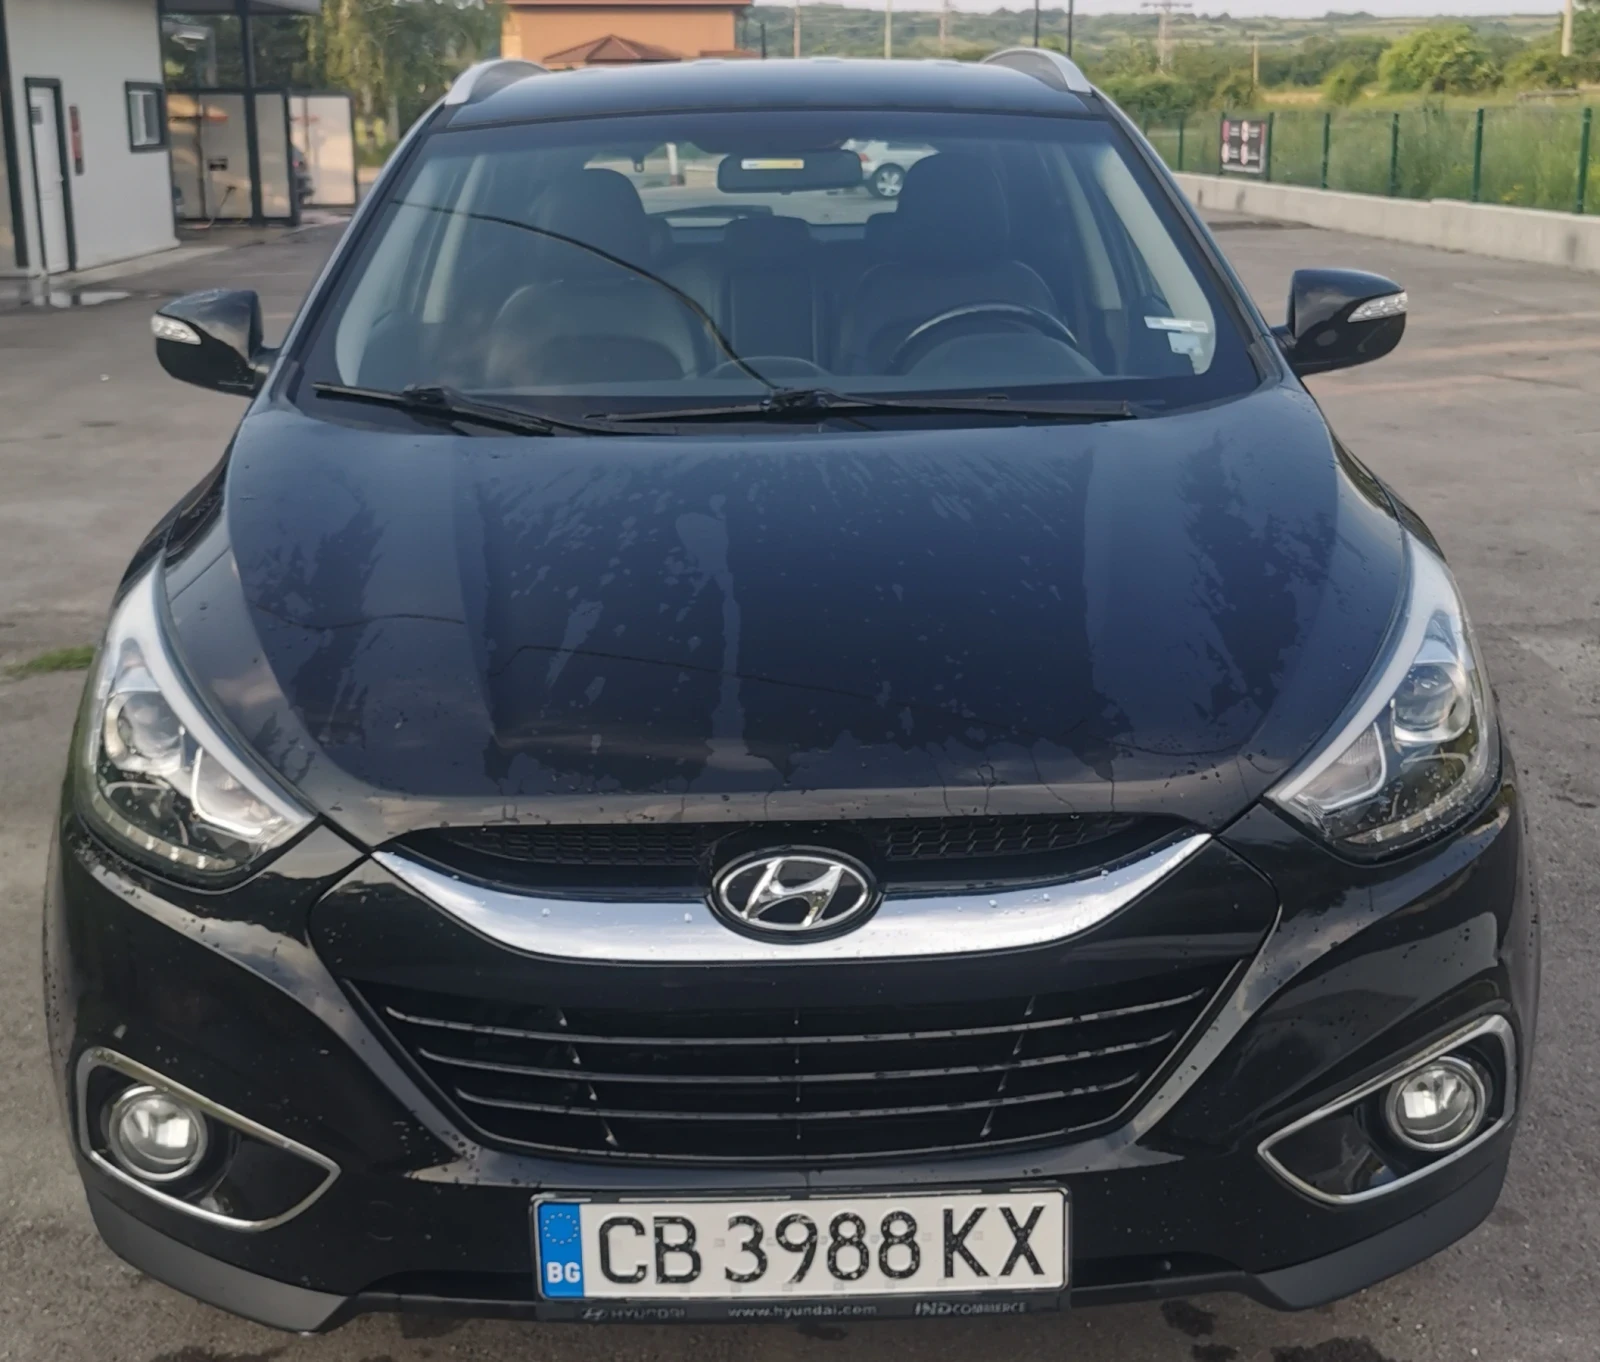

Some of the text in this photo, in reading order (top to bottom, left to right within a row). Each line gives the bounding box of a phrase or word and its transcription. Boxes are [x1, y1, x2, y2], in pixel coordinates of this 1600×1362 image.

[598, 1205, 1047, 1285] CB 3988 KX
[546, 1261, 581, 1284] BG
[727, 1304, 878, 1319] www.hyundai.com
